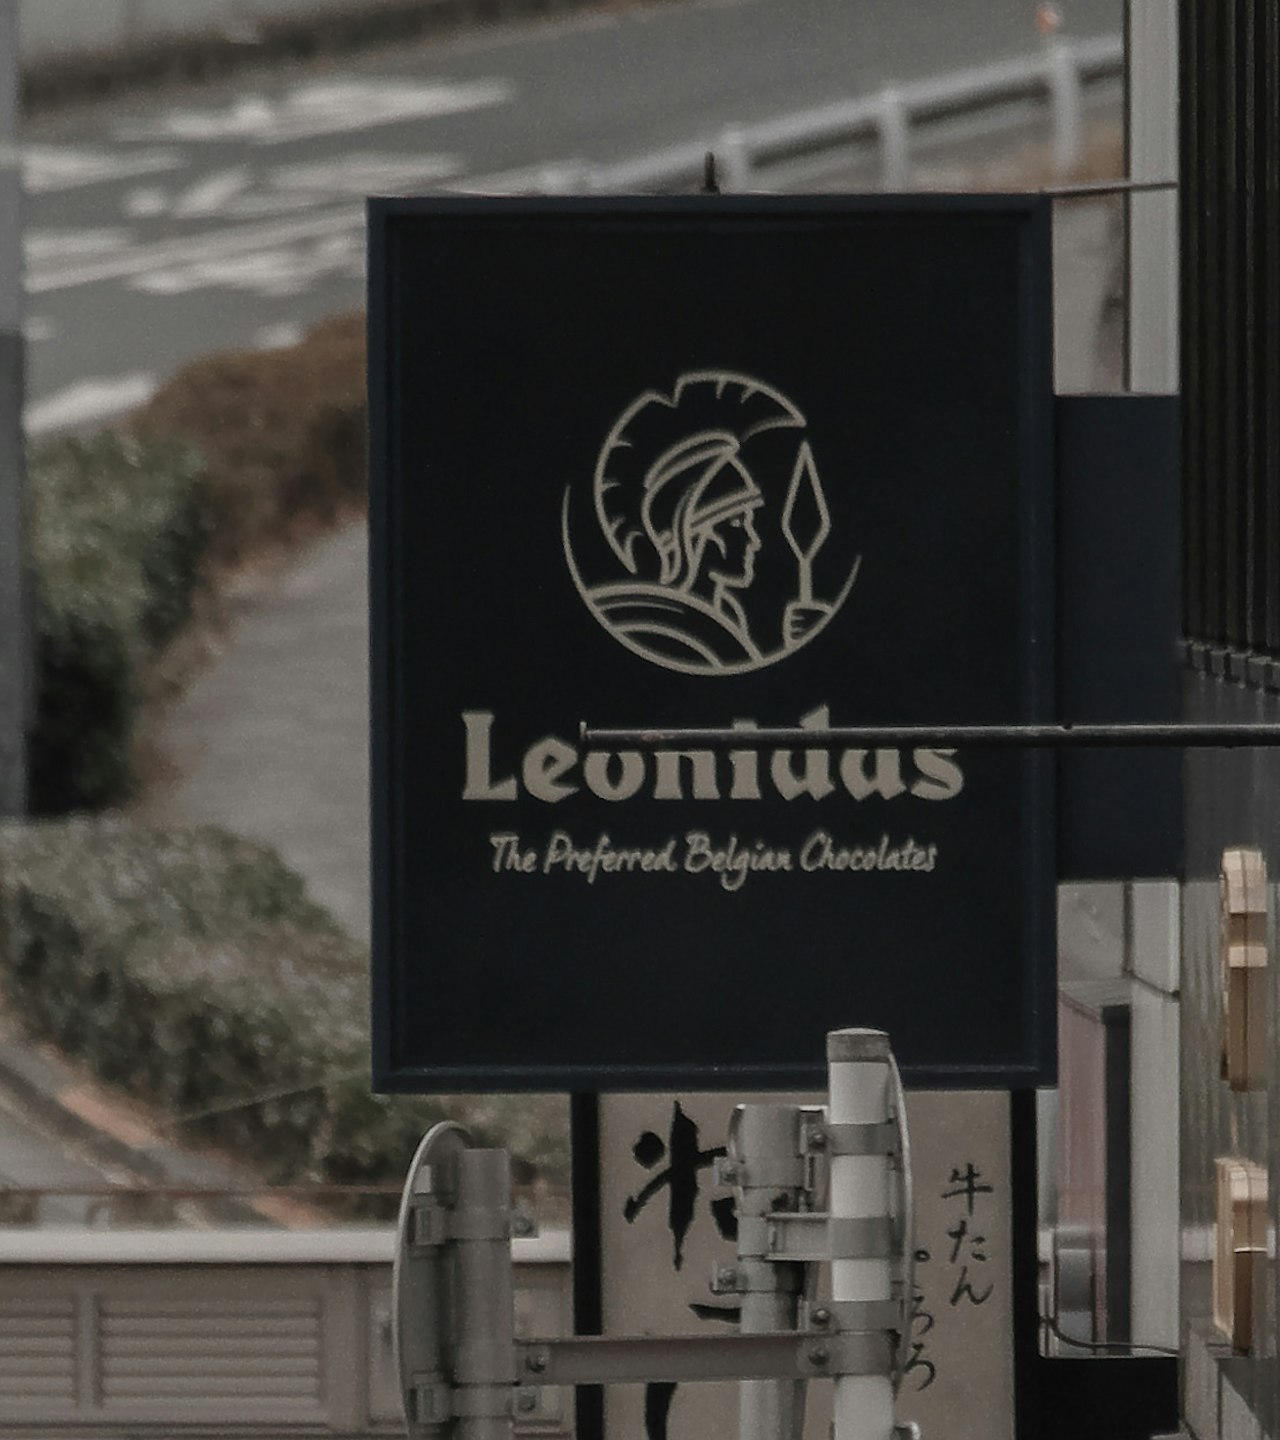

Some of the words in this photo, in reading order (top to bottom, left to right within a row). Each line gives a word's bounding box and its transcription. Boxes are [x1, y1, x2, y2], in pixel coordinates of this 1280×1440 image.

[461, 703, 965, 803] Leonidas
[489, 834, 537, 873] The
[544, 833, 677, 884] Preferred
[685, 832, 793, 893] Belgian
[800, 833, 939, 874] Chocolates
[941, 1162, 994, 1306] 牛たん
